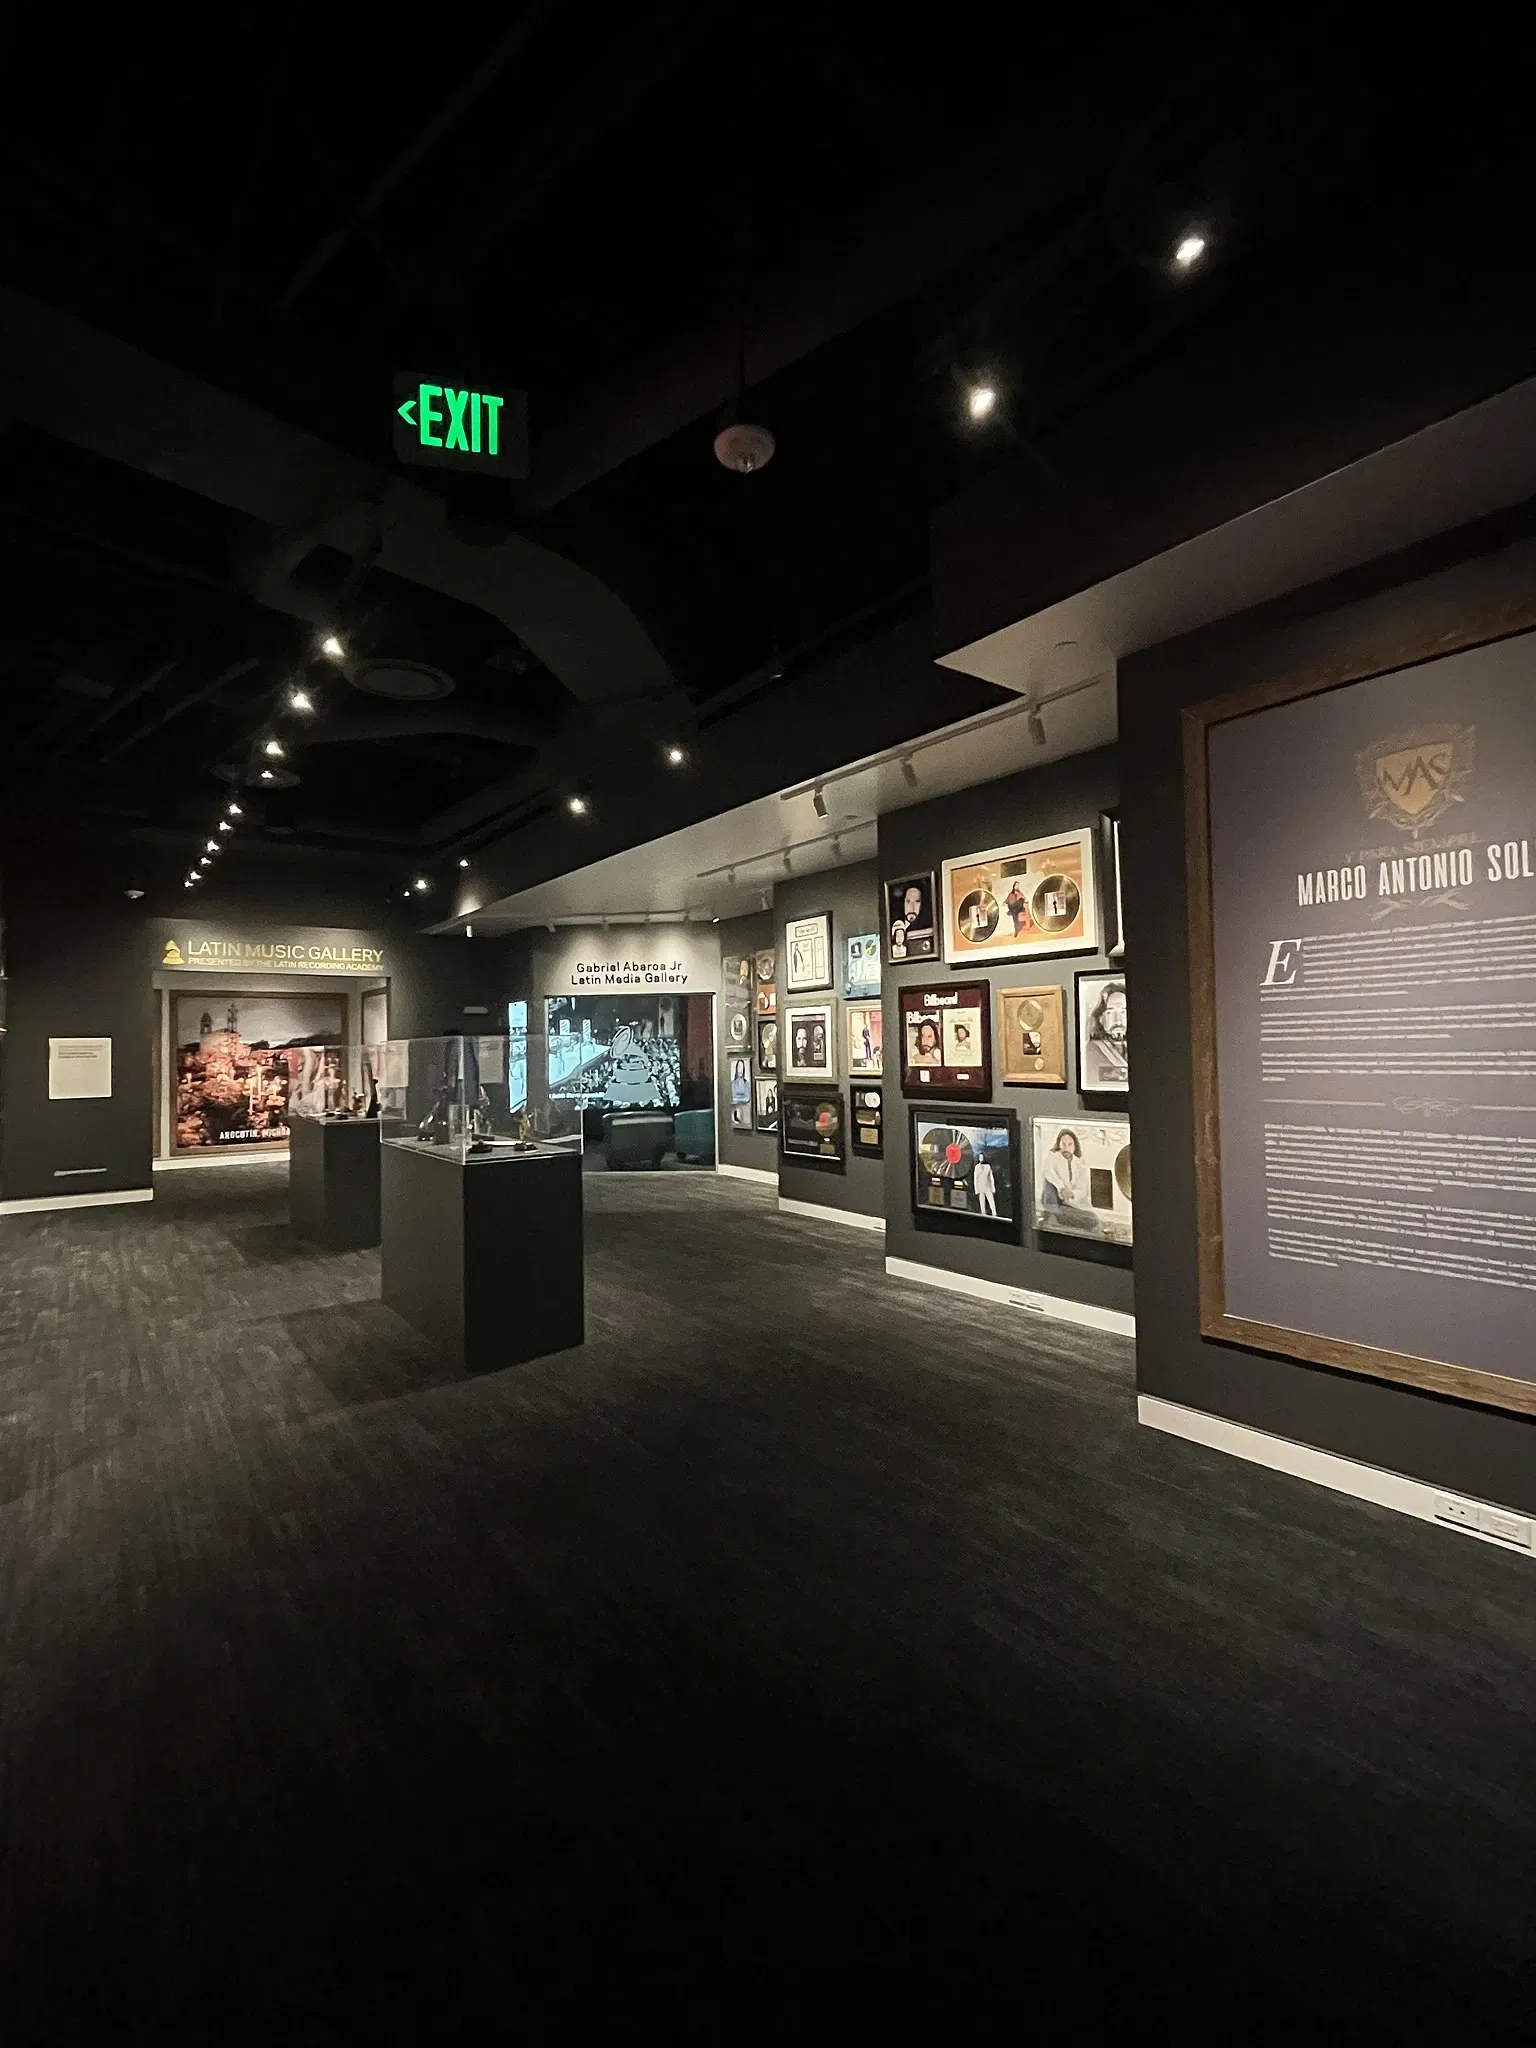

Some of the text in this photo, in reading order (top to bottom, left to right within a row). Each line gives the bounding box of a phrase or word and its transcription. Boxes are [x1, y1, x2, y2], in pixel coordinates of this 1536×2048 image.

[419, 383, 504, 455] EXIT
[1297, 865, 1367, 906] MARCO
[1378, 849, 1473, 896] ANTONIO
[1487, 840, 1535, 882] SOL
[188, 940, 384, 962] LATIN MUSIC GALLERY
[188, 956, 242, 967] PRESENTED
[257, 960, 272, 968] THE
[274, 960, 297, 969] LATIN
[298, 961, 345, 970] RECORDING
[345, 963, 384, 972] ACADEMY
[576, 960, 683, 973] Gabriel Abaroa Jr
[571, 972, 688, 985] Latin Media Gallery
[923, 992, 958, 1007] Billboard
